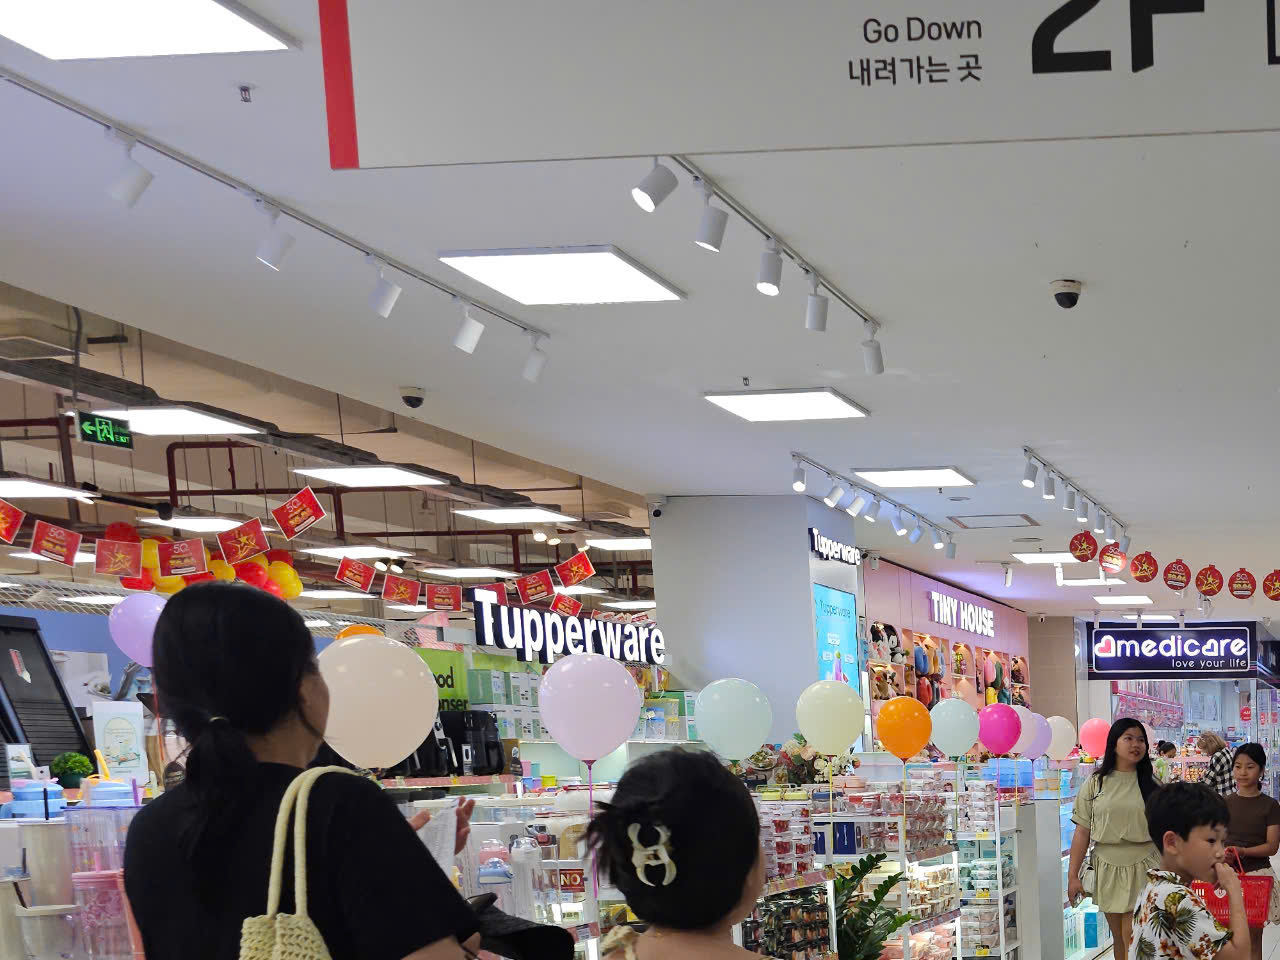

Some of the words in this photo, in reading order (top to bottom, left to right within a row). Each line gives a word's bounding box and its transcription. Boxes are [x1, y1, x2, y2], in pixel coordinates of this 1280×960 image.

[863, 18, 899, 45] Go
[906, 16, 983, 41] Down
[848, 56, 951, 87] 내려가는
[958, 53, 983, 83] 곳
[812, 527, 861, 566] Tupperware
[819, 599, 851, 619] Tupperware
[930, 590, 959, 628] TINY
[959, 600, 995, 638] HOUSE
[473, 587, 666, 664] Tupperware
[1117, 635, 1248, 658] medicare
[1172, 658, 1195, 668] love
[1200, 659, 1225, 670] your
[1229, 658, 1247, 668] life
